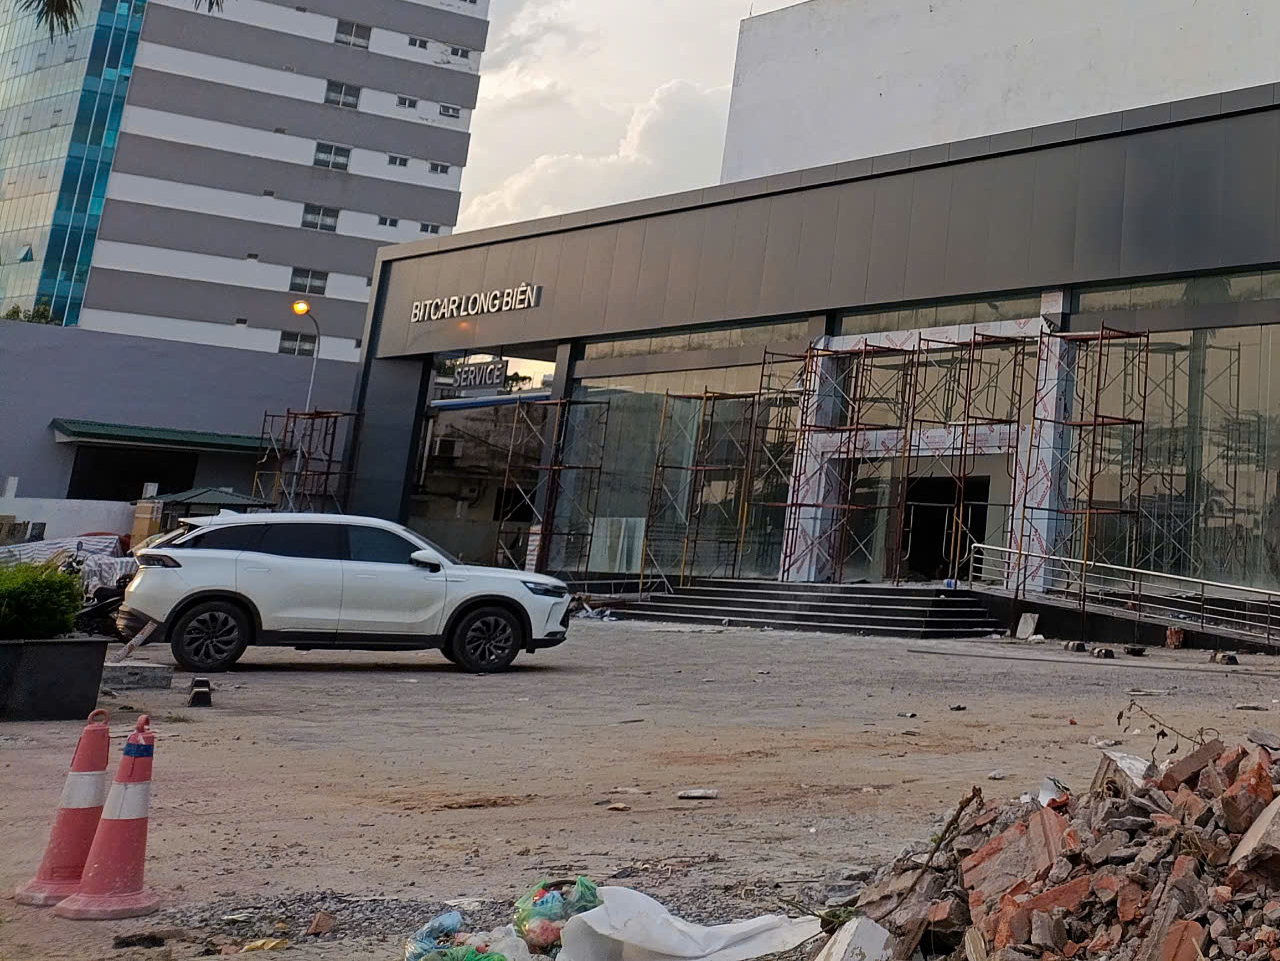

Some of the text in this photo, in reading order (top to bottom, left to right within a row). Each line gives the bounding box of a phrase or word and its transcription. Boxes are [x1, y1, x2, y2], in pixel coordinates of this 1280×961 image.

[411, 282, 537, 323] BITCAR LONG BIÊN
[453, 364, 503, 387] SERVICE
